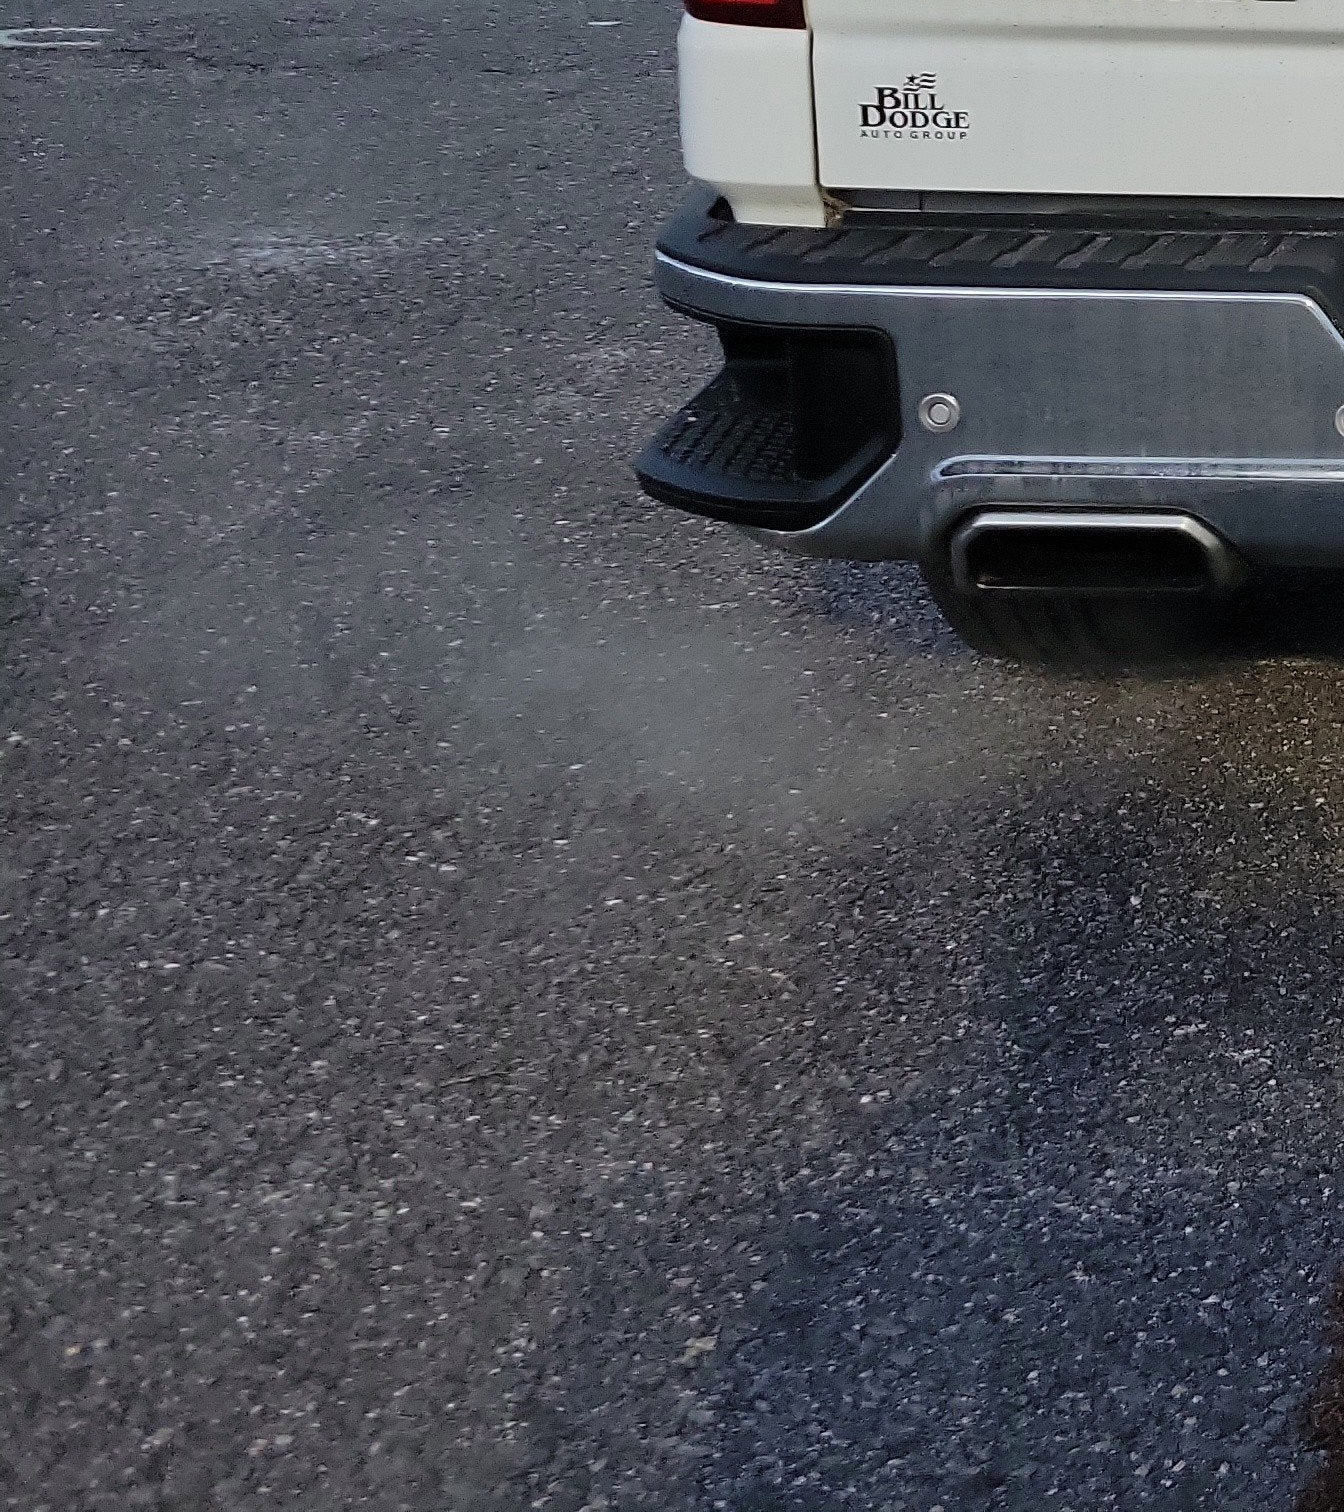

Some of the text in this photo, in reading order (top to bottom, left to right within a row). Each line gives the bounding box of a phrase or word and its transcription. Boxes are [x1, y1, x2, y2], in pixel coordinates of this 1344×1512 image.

[875, 86, 945, 110] BILL
[858, 103, 970, 129] DODGE
[860, 130, 968, 140] AUTO GROUP
